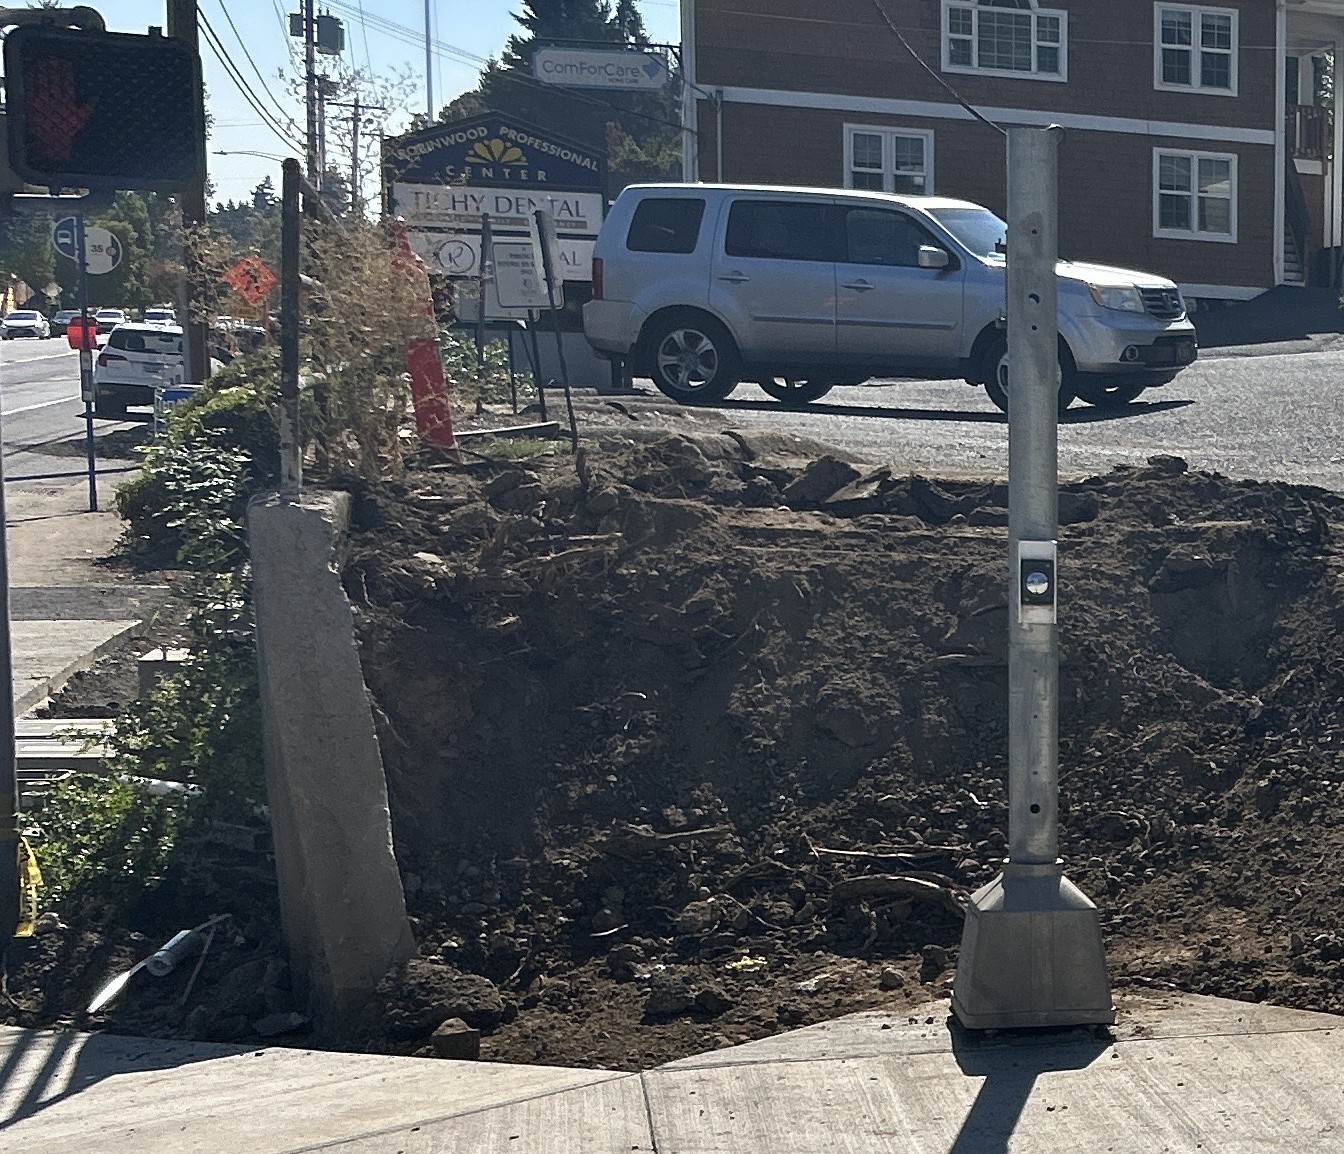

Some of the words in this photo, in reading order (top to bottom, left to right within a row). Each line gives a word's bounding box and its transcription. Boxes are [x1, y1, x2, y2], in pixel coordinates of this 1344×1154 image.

[542, 60, 640, 77] ComForCare
[499, 126, 599, 172] PROFESSIONAL
[445, 164, 548, 182] CENTER
[494, 195, 587, 218] DENTAL
